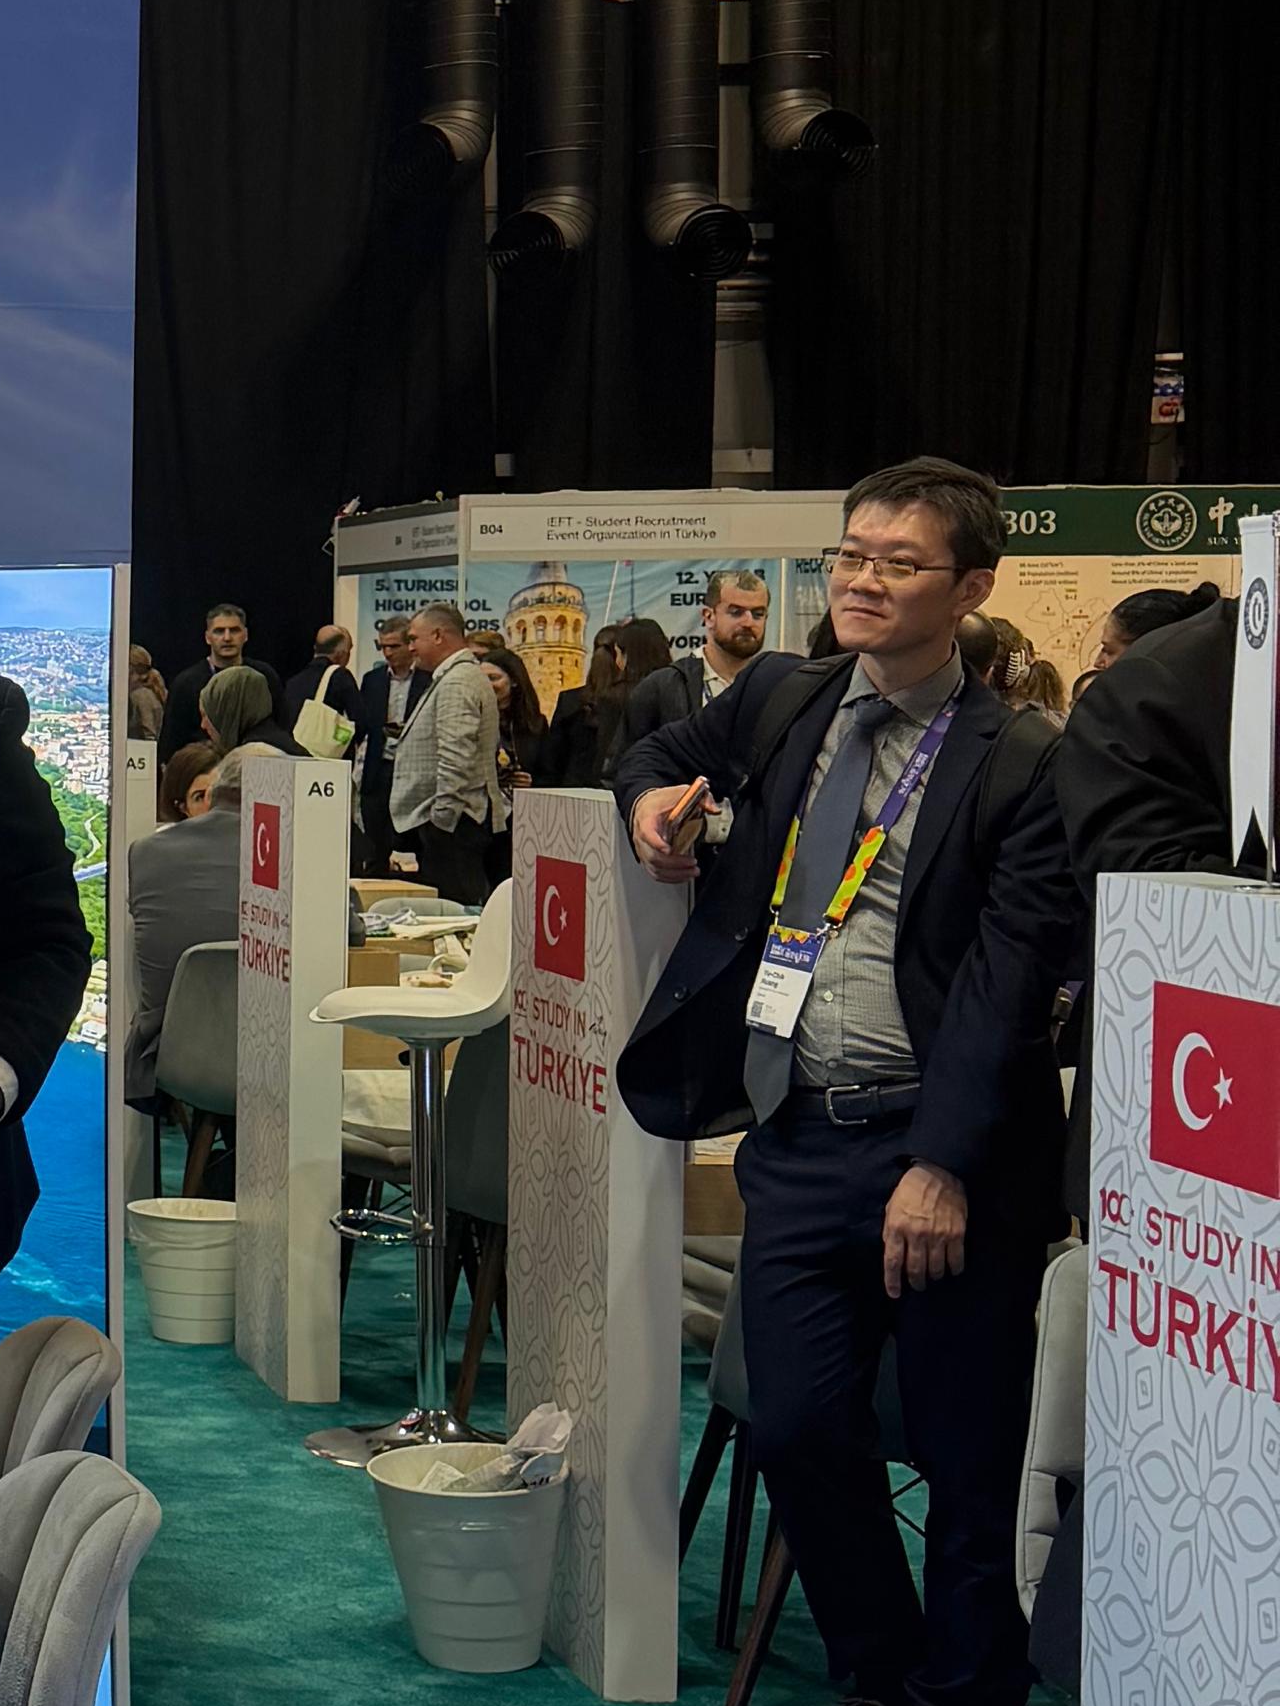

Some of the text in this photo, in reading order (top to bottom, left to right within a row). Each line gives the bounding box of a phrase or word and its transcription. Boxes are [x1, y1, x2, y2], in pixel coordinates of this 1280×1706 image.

[586, 515, 631, 527] Student
[479, 524, 503, 535] B04
[547, 529, 579, 541] Event
[583, 529, 657, 543] Organization
[676, 571, 699, 585] 12.
[375, 579, 389, 592] 5.
[375, 599, 416, 612] HIGH
[126, 756, 146, 770] A5
[308, 781, 335, 798] A6
[241, 927, 290, 983] TÜRKİYE
[533, 996, 571, 1033] STUDY
[573, 1008, 587, 1038] IN
[513, 1028, 607, 1115] TÜRKİYE
[1146, 1205, 1244, 1275] STUDY
[1251, 1240, 1280, 1293] IN
